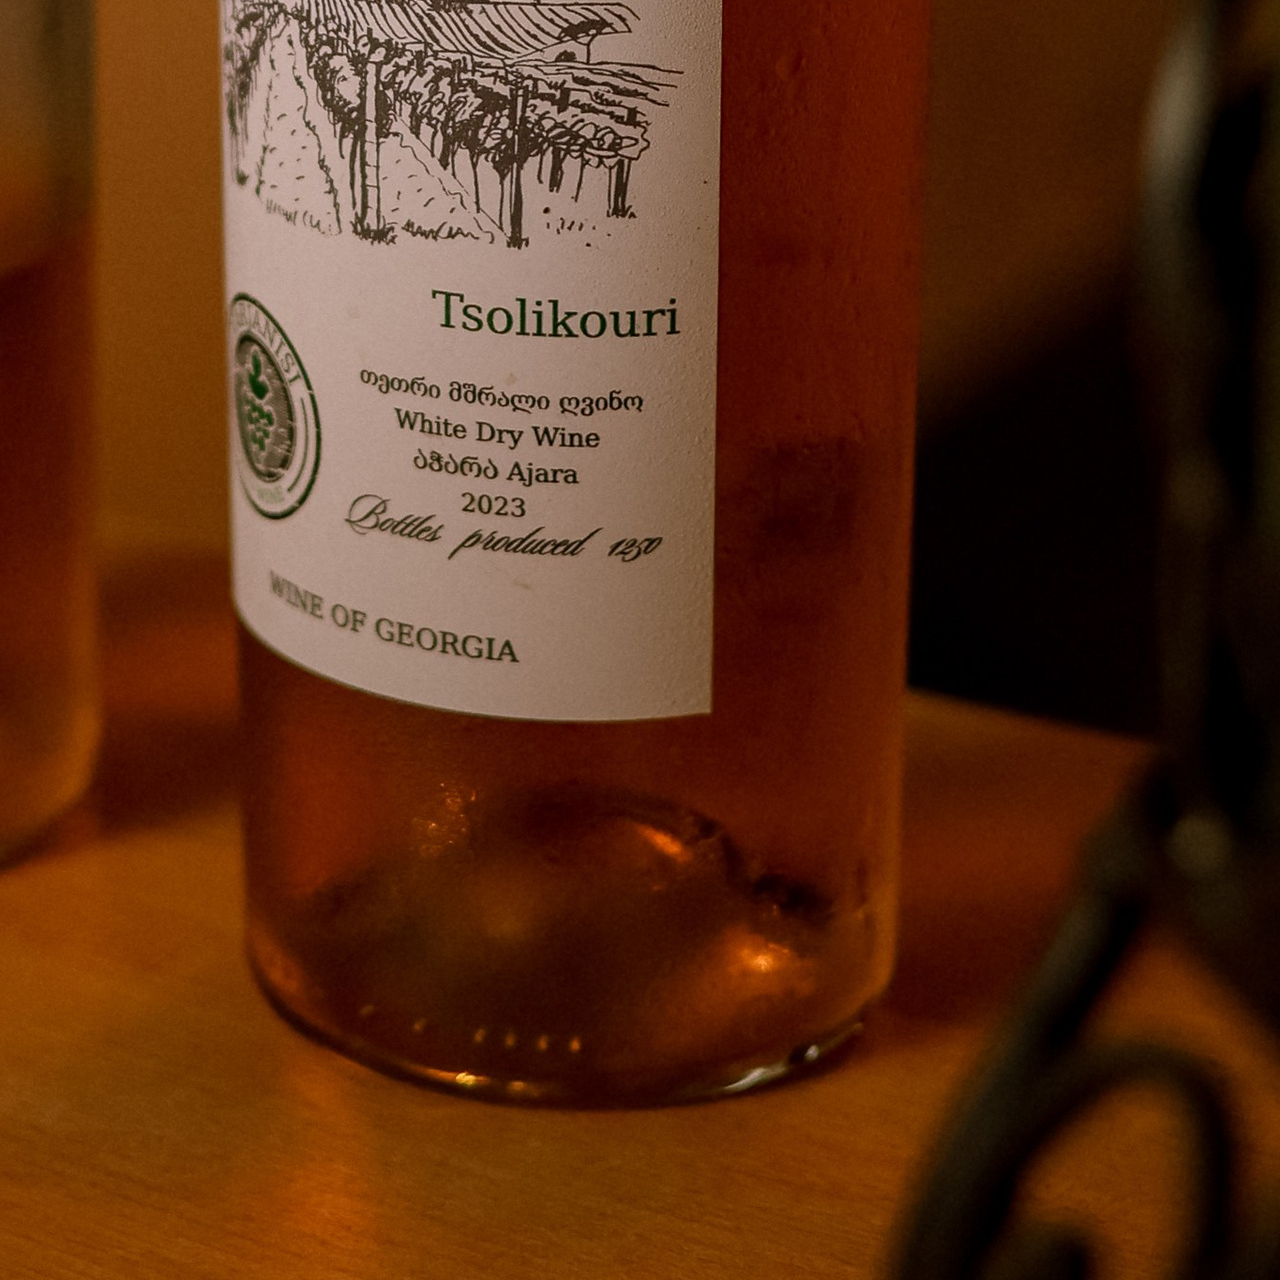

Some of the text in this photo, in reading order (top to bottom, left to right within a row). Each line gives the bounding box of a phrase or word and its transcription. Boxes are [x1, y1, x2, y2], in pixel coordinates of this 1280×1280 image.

[431, 289, 681, 338] Tsolikouri
[360, 368, 644, 417] თეთრი მშრალი ღვინო
[394, 408, 601, 450] White Dry Wine
[413, 448, 579, 487] აჭარა Ajara
[344, 494, 664, 562] Bottles produced 1250
[461, 492, 526, 517] 2023
[269, 569, 520, 663] WINE OF GEORGIA
